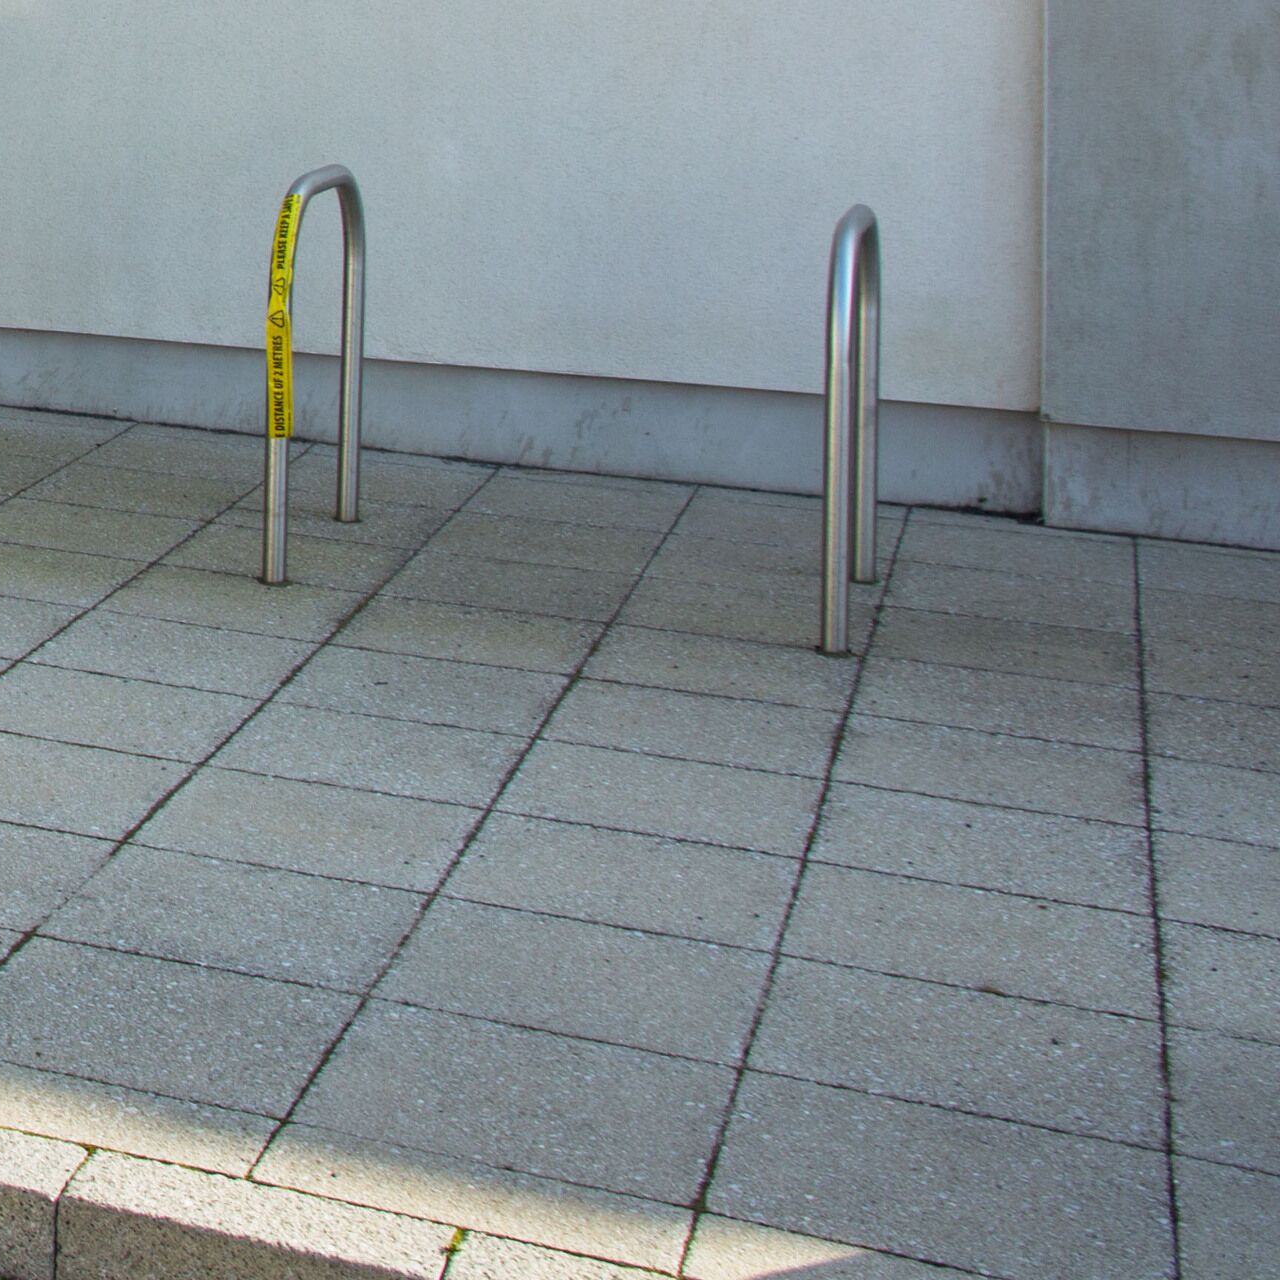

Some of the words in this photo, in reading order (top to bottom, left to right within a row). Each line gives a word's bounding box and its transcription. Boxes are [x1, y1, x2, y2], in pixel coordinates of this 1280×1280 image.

[280, 220, 289, 238] KEEP
[277, 240, 287, 269] PLEASE
[272, 335, 283, 369] METRES
[273, 378, 283, 389] OF
[274, 391, 285, 431] DISTANCE
